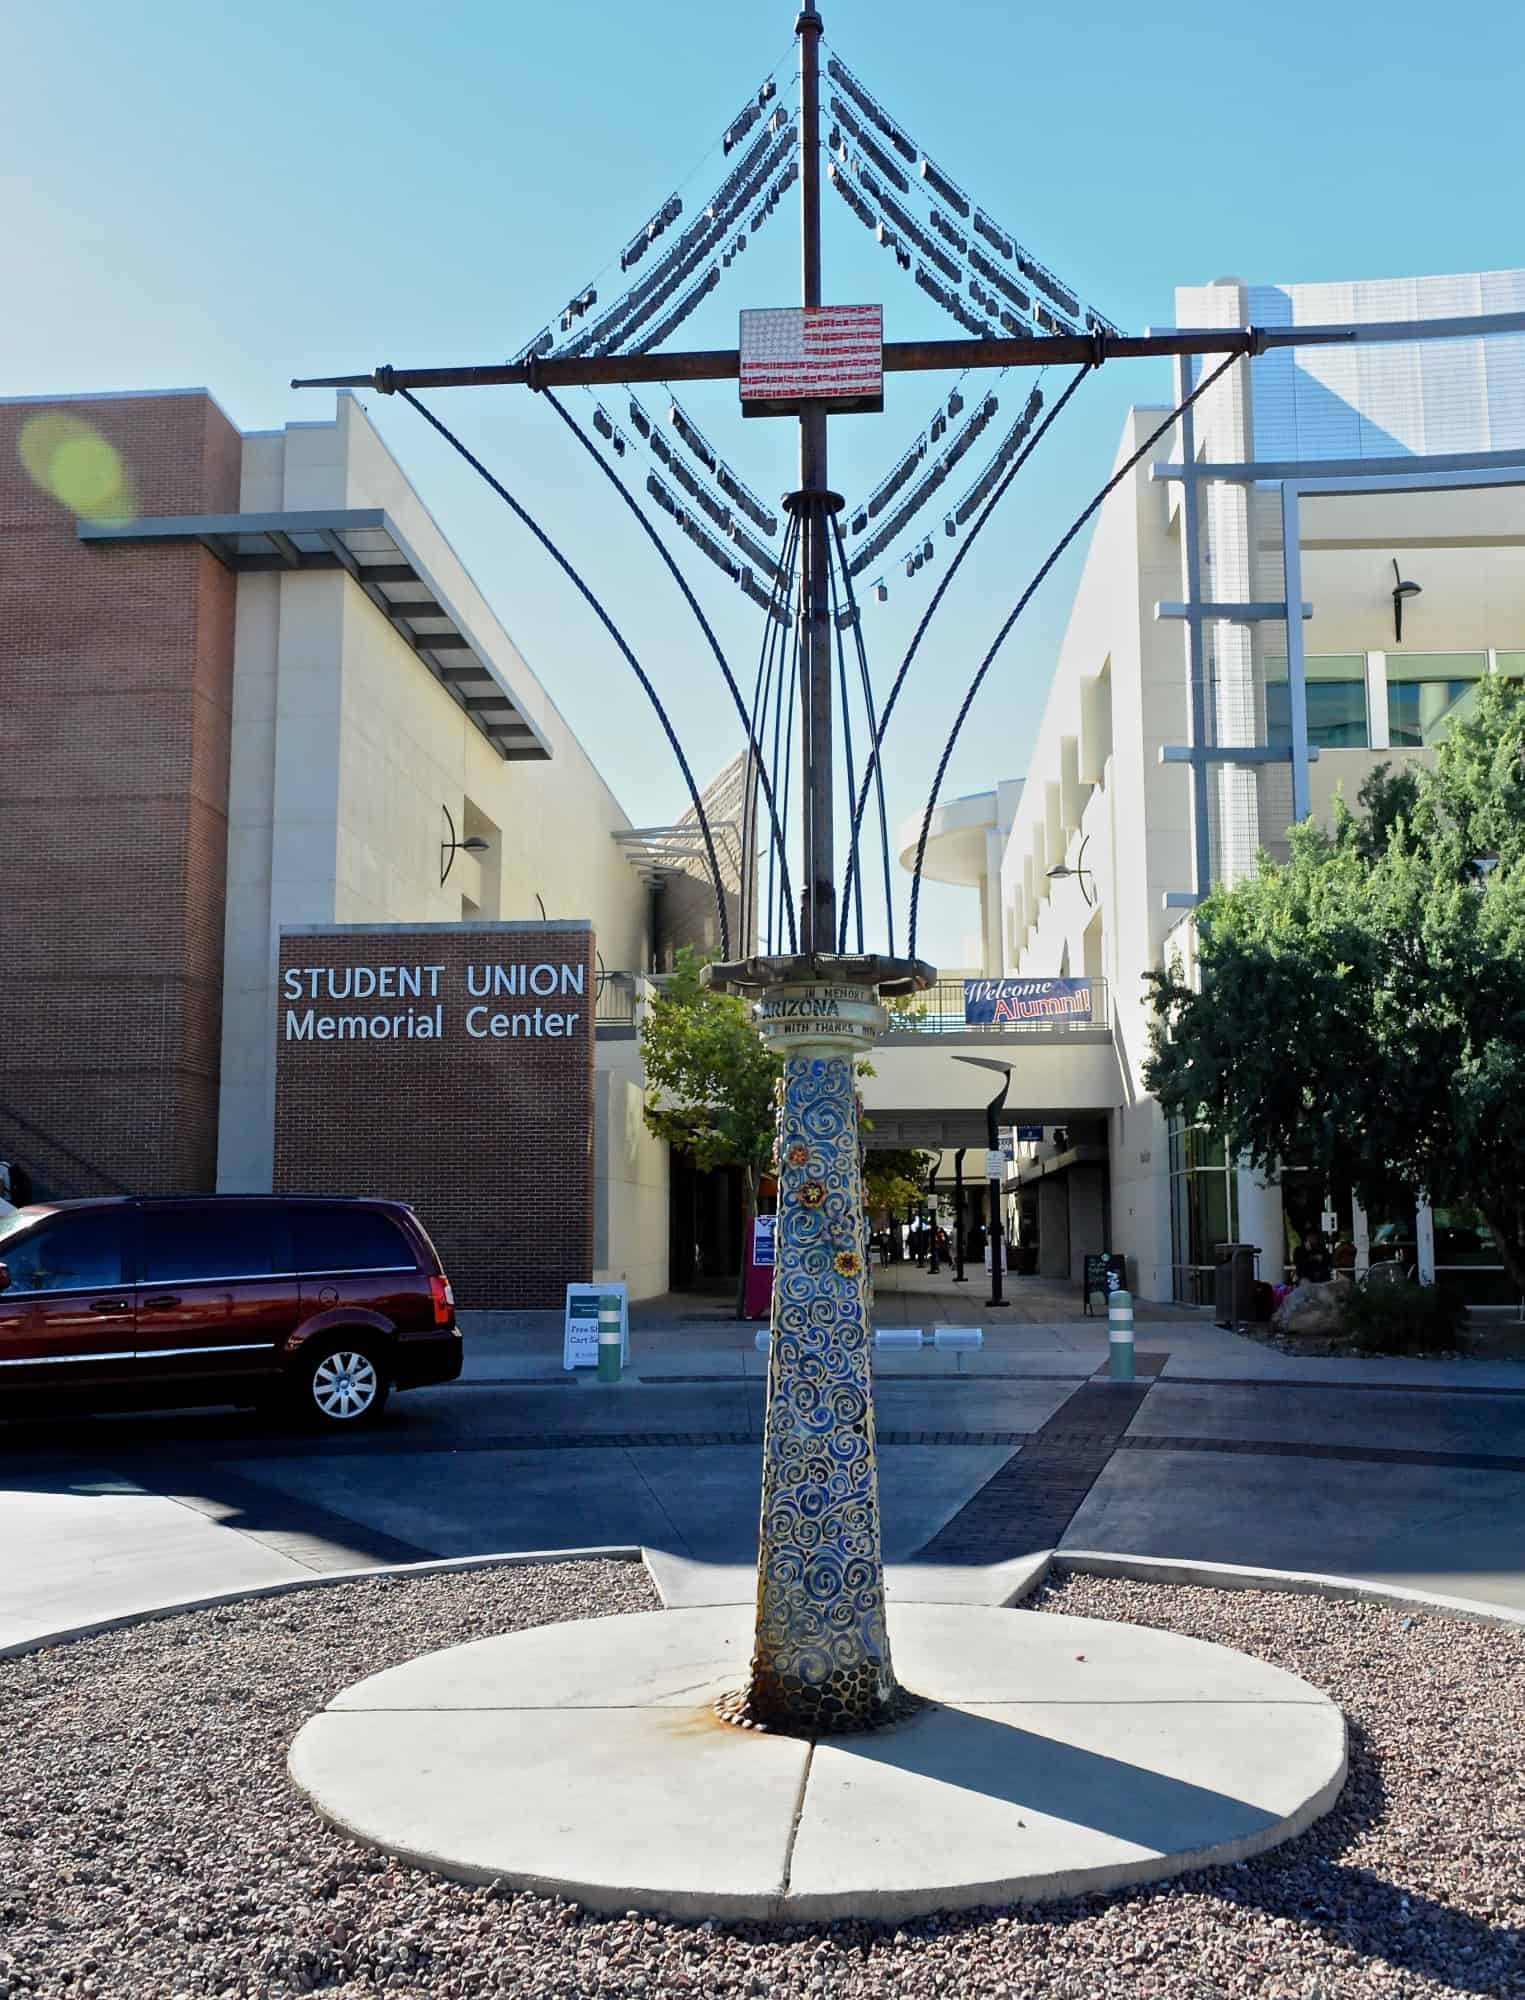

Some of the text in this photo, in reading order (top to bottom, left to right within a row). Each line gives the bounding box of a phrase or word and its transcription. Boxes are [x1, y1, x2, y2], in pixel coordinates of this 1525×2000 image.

[284, 963, 584, 999] STUDENT UNION
[964, 980, 1052, 1004] Welcome
[762, 1000, 840, 1019] ARIZONA
[991, 988, 1091, 1024] Alumni!
[285, 1005, 579, 1040] Memorial Center
[784, 1023, 809, 1033] WITH
[816, 1023, 854, 1033] THANKS
